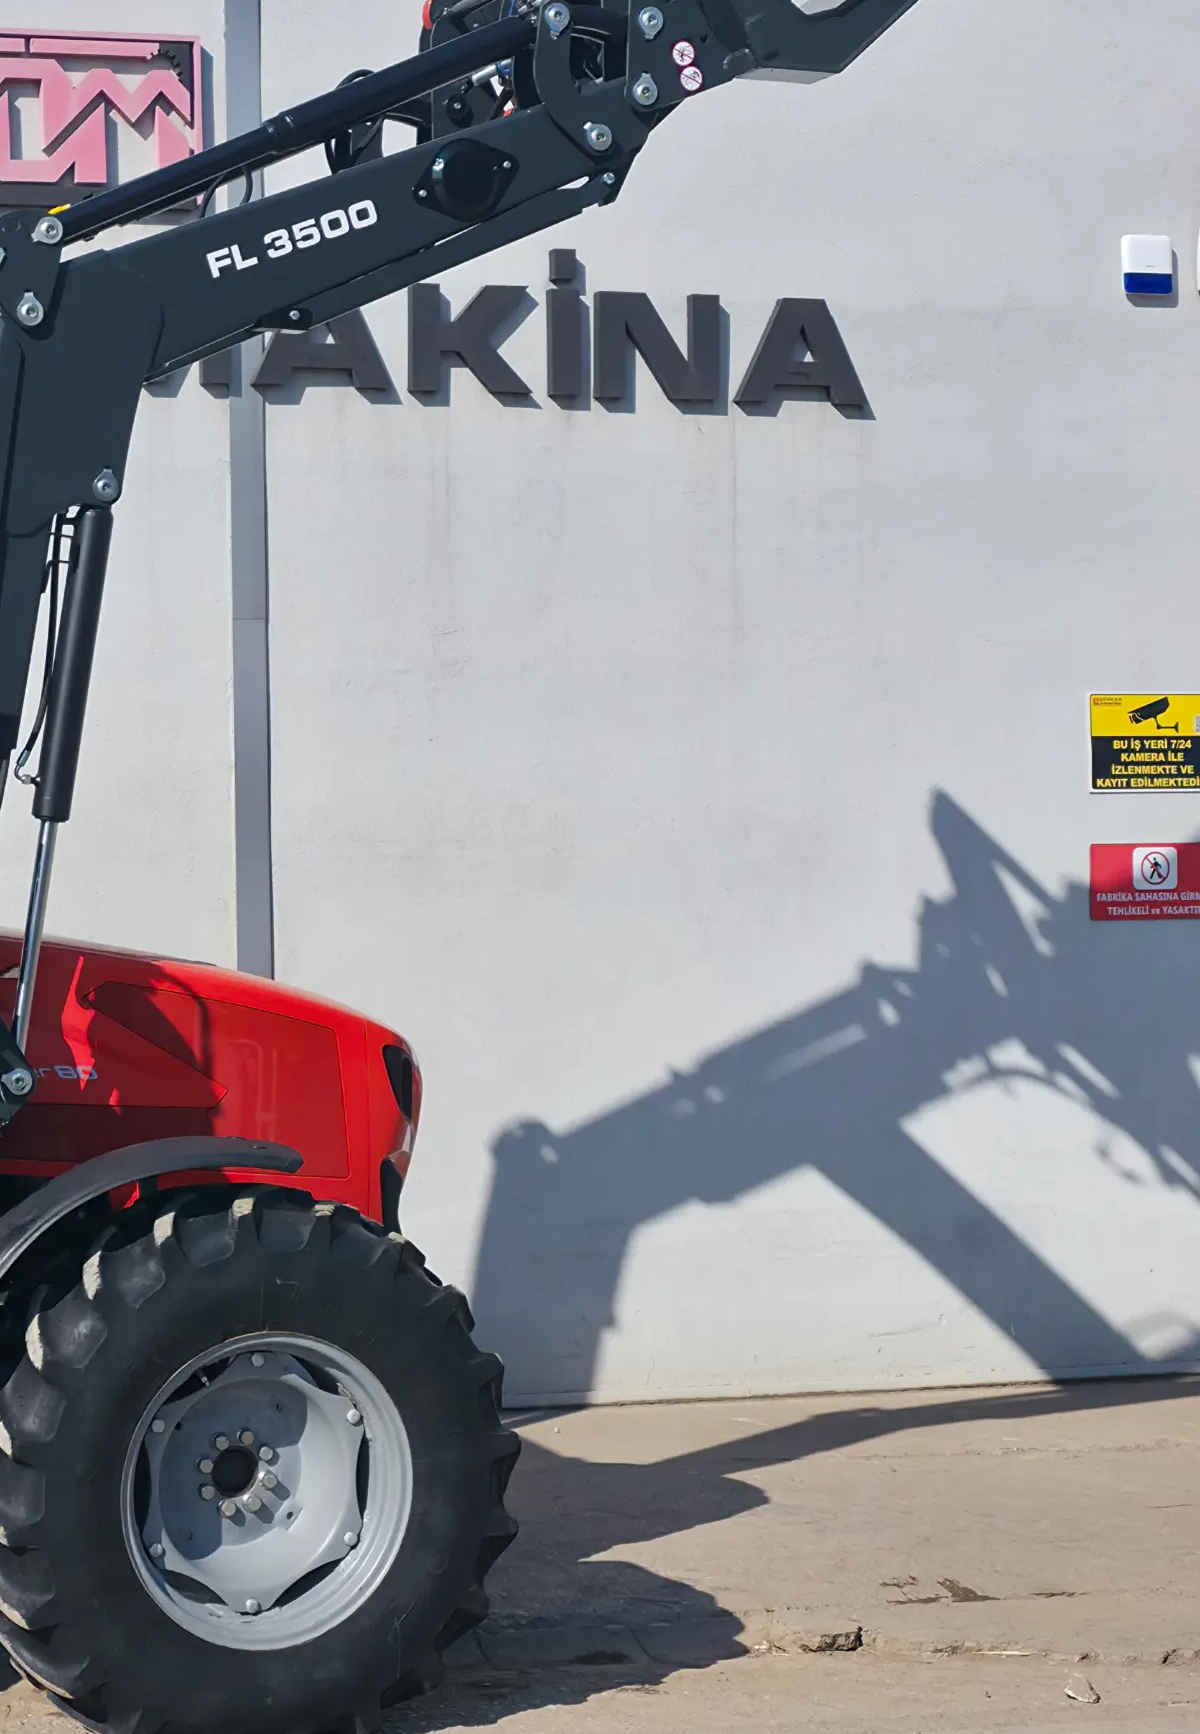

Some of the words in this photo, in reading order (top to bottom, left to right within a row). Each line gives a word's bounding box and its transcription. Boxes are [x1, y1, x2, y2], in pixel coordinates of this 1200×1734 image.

[206, 243, 259, 279] FL
[263, 199, 378, 259] 3500
[142, 248, 866, 413] AKİNA
[1112, 739, 1128, 749] BU
[1131, 738, 1141, 751] İŞ
[1143, 738, 1168, 749] YERİ
[1170, 739, 1192, 749] 7/24
[1120, 752, 1166, 762] KAMERA
[1167, 751, 1185, 762] İLE
[1111, 763, 1178, 775] İZLENMEKTE
[1180, 765, 1195, 774] VE
[1096, 778, 1128, 787] KAYIT
[1096, 892, 1133, 902] FABRİKA
[1135, 892, 1179, 901] SAHASINA
[1107, 905, 1149, 915] TEHLİKELİ
